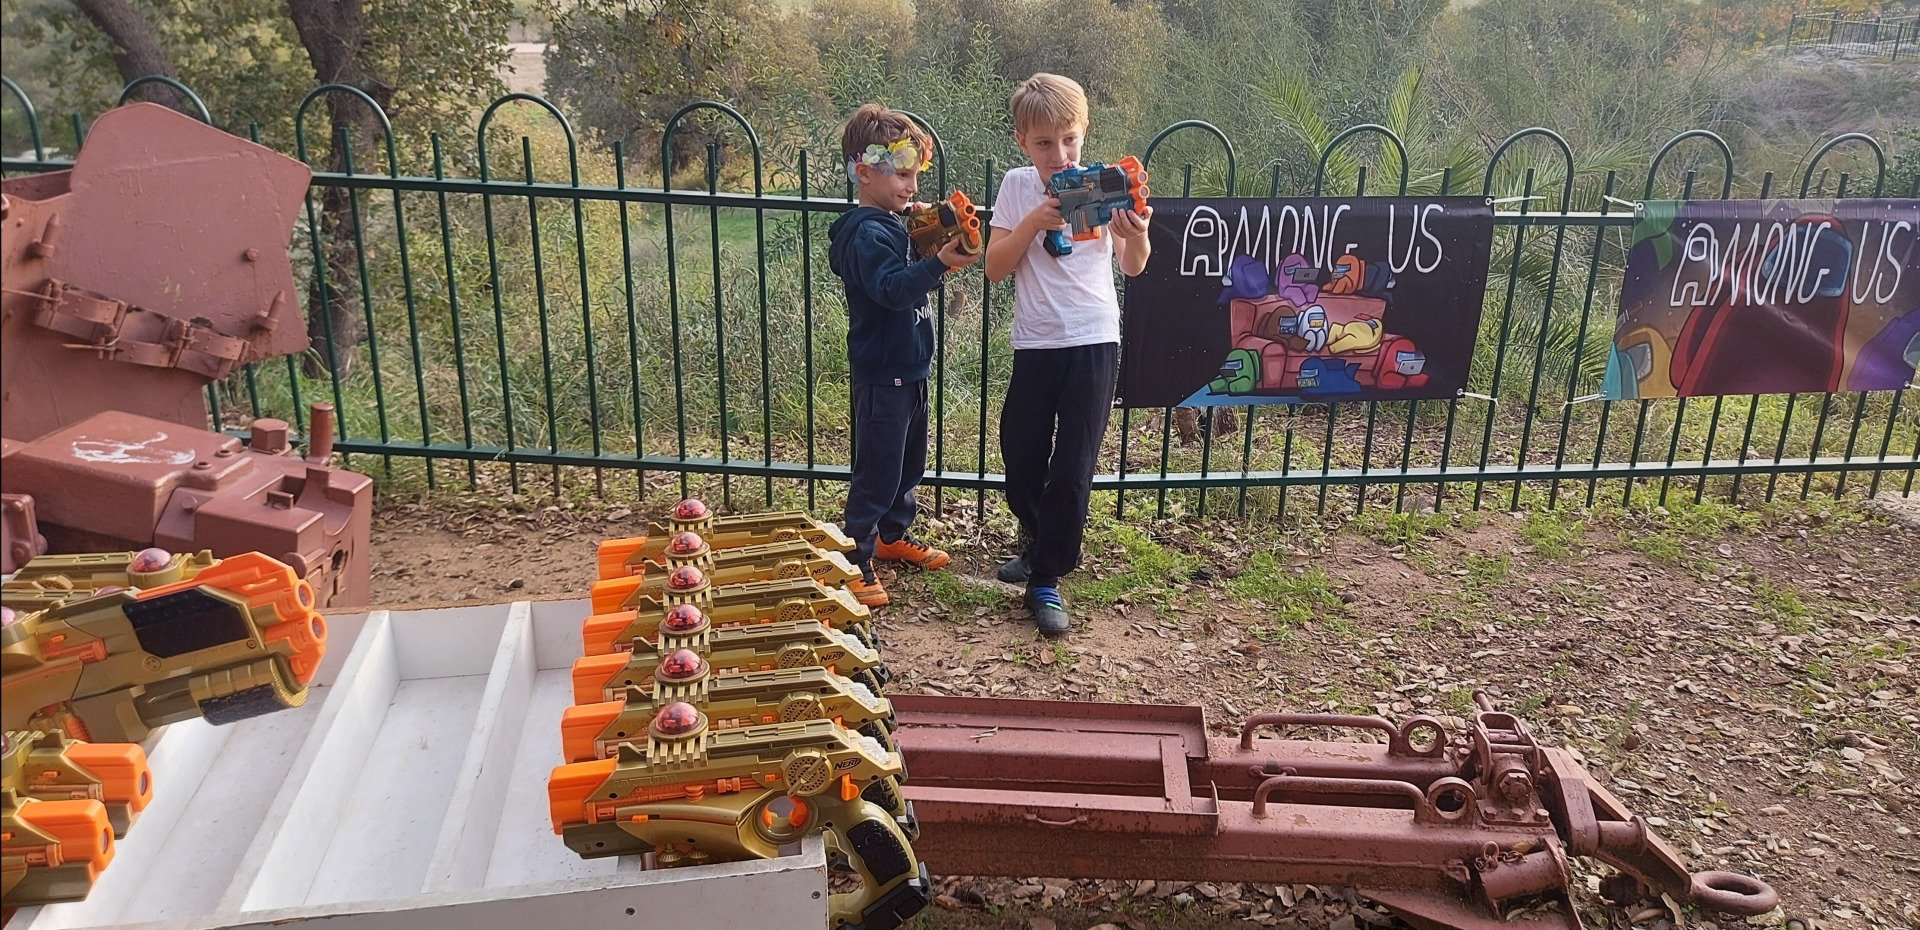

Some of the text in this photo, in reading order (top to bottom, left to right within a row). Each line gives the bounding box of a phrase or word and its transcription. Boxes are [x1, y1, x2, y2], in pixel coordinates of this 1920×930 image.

[1180, 204, 1444, 276] AMONG US
[1670, 220, 1911, 307] AMONG US
[816, 604, 839, 616] NERF
[820, 651, 846, 663] NERF
[833, 757, 862, 770] NERF
